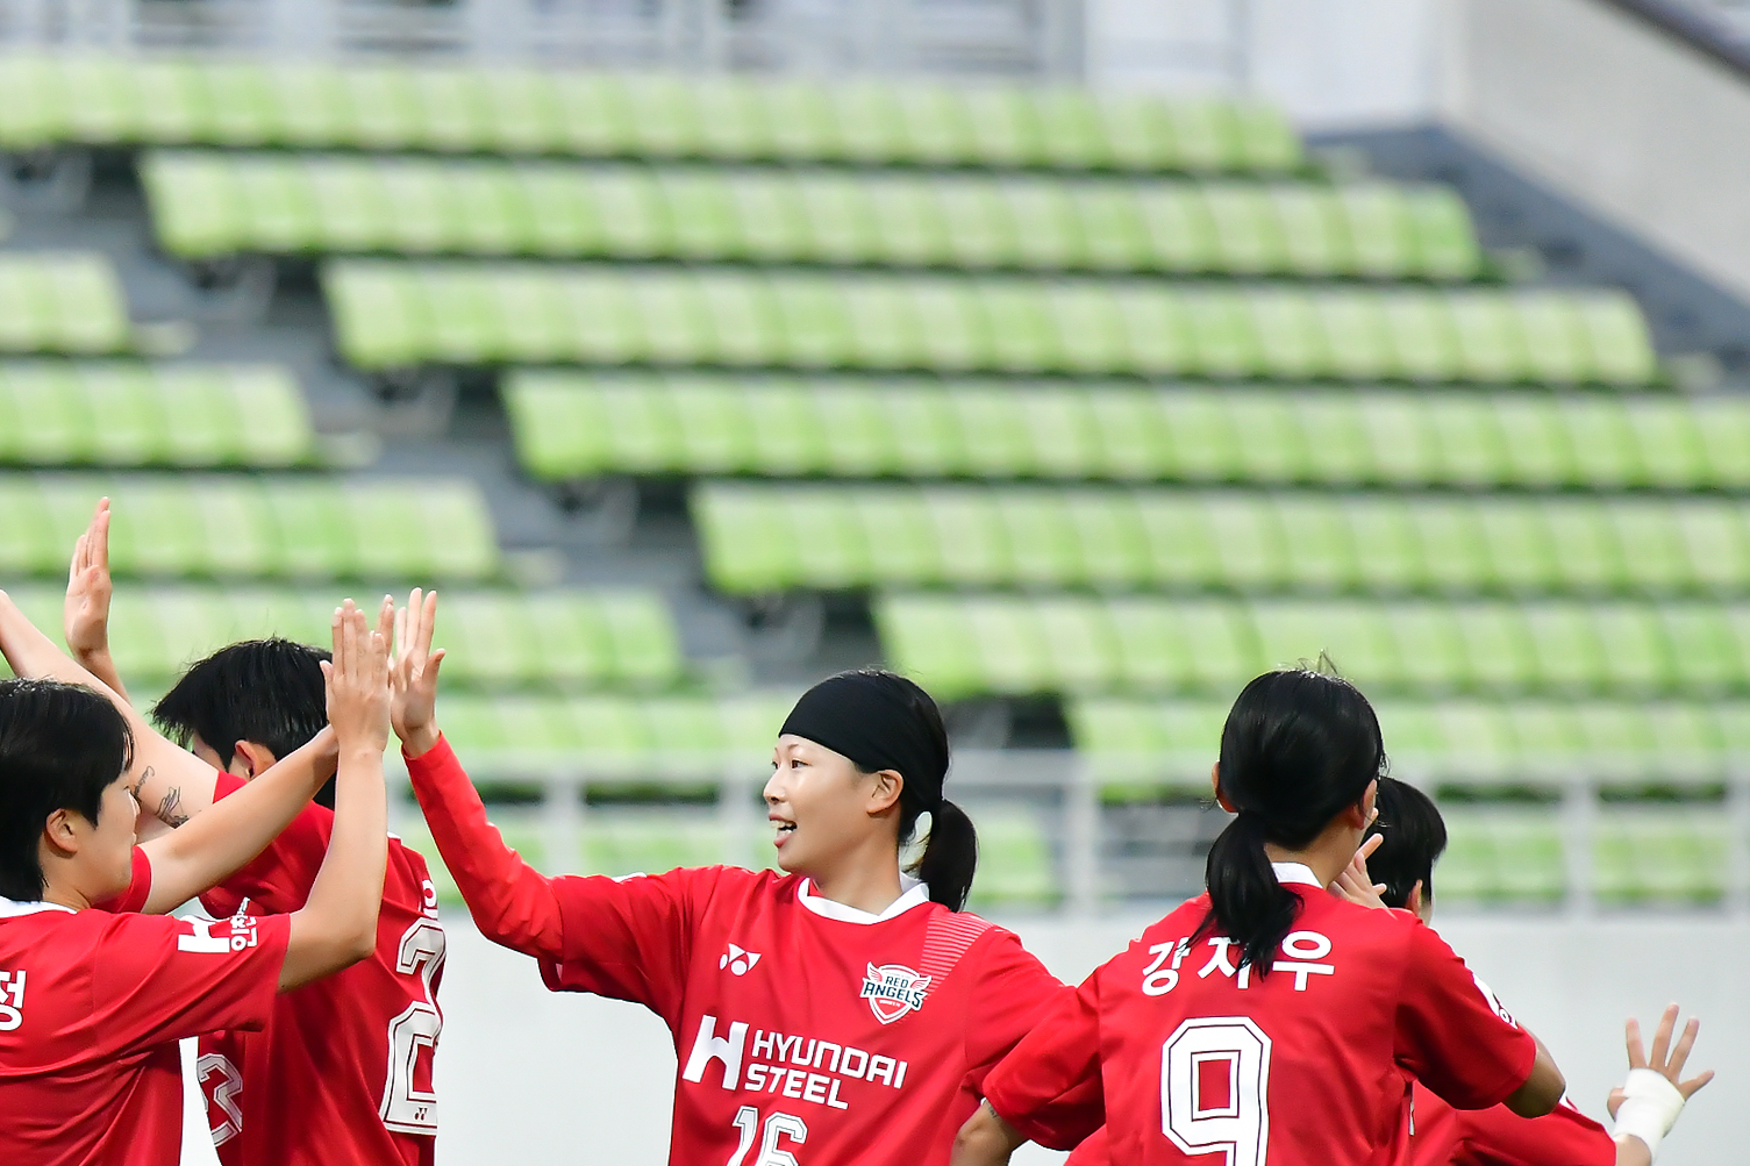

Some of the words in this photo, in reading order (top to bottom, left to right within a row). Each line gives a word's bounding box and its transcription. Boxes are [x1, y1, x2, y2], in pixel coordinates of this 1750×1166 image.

[885, 976, 909, 988] RED
[1141, 930, 1335, 996] 강지우
[863, 981, 924, 1008] ANGELS
[751, 1029, 908, 1089] HYUNDAI
[744, 1063, 849, 1110] STEEL
